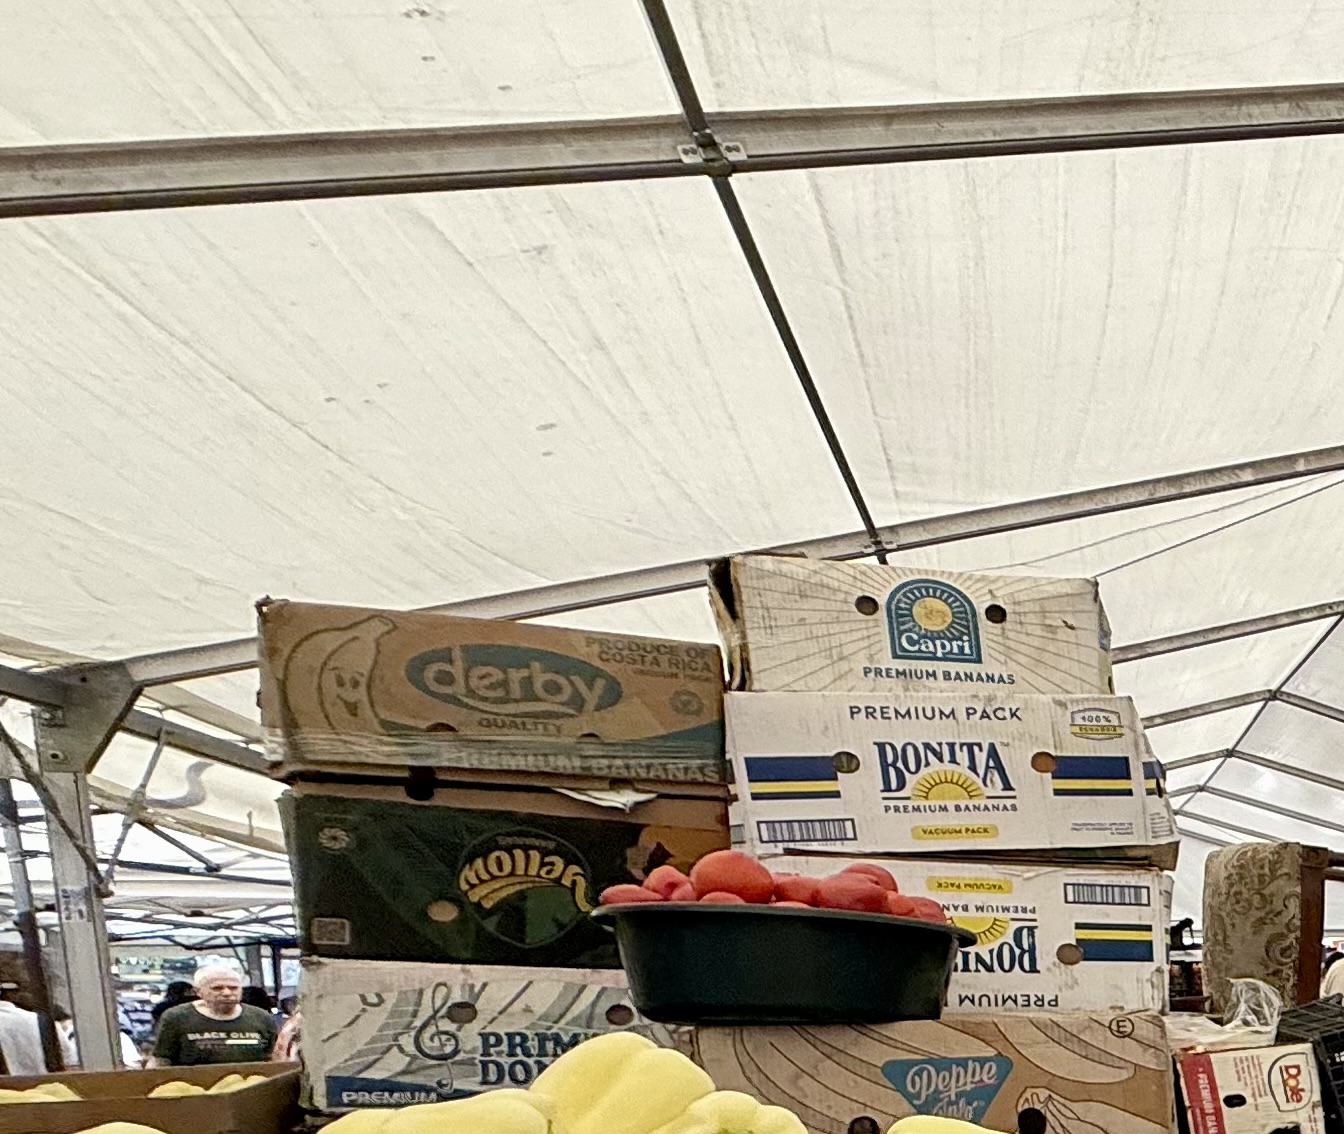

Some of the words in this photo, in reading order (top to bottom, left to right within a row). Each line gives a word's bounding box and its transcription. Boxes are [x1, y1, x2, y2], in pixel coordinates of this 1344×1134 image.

[585, 636, 682, 657] PRODUCE
[901, 633, 972, 660] Capri
[598, 651, 662, 668] COSTA
[668, 658, 714, 673] RICA
[423, 645, 607, 716] derby
[863, 666, 938, 681] PREMIUM
[942, 670, 1015, 685] BANANAS
[849, 705, 958, 721] PREMIUM
[966, 706, 1022, 721] PACK
[477, 717, 565, 735] QUALITY
[594, 759, 720, 782] BANANAS
[873, 741, 1016, 792] BONITA
[884, 804, 949, 814] PREMIUM
[954, 803, 1018, 813] BANANAS
[922, 827, 963, 835] VACUUM
[965, 826, 990, 835] PACK
[936, 880, 961, 890] PACK
[963, 882, 1004, 891] VACUUM
[975, 904, 1036, 914] PREMIUM
[953, 925, 1040, 974] BONI
[958, 994, 1059, 1008] PREMIUM
[479, 1031, 597, 1058] PRIM
[906, 1060, 998, 1105] Peppe
[1282, 1064, 1306, 1104] Dole
[341, 1090, 438, 1105] PREMIUM
